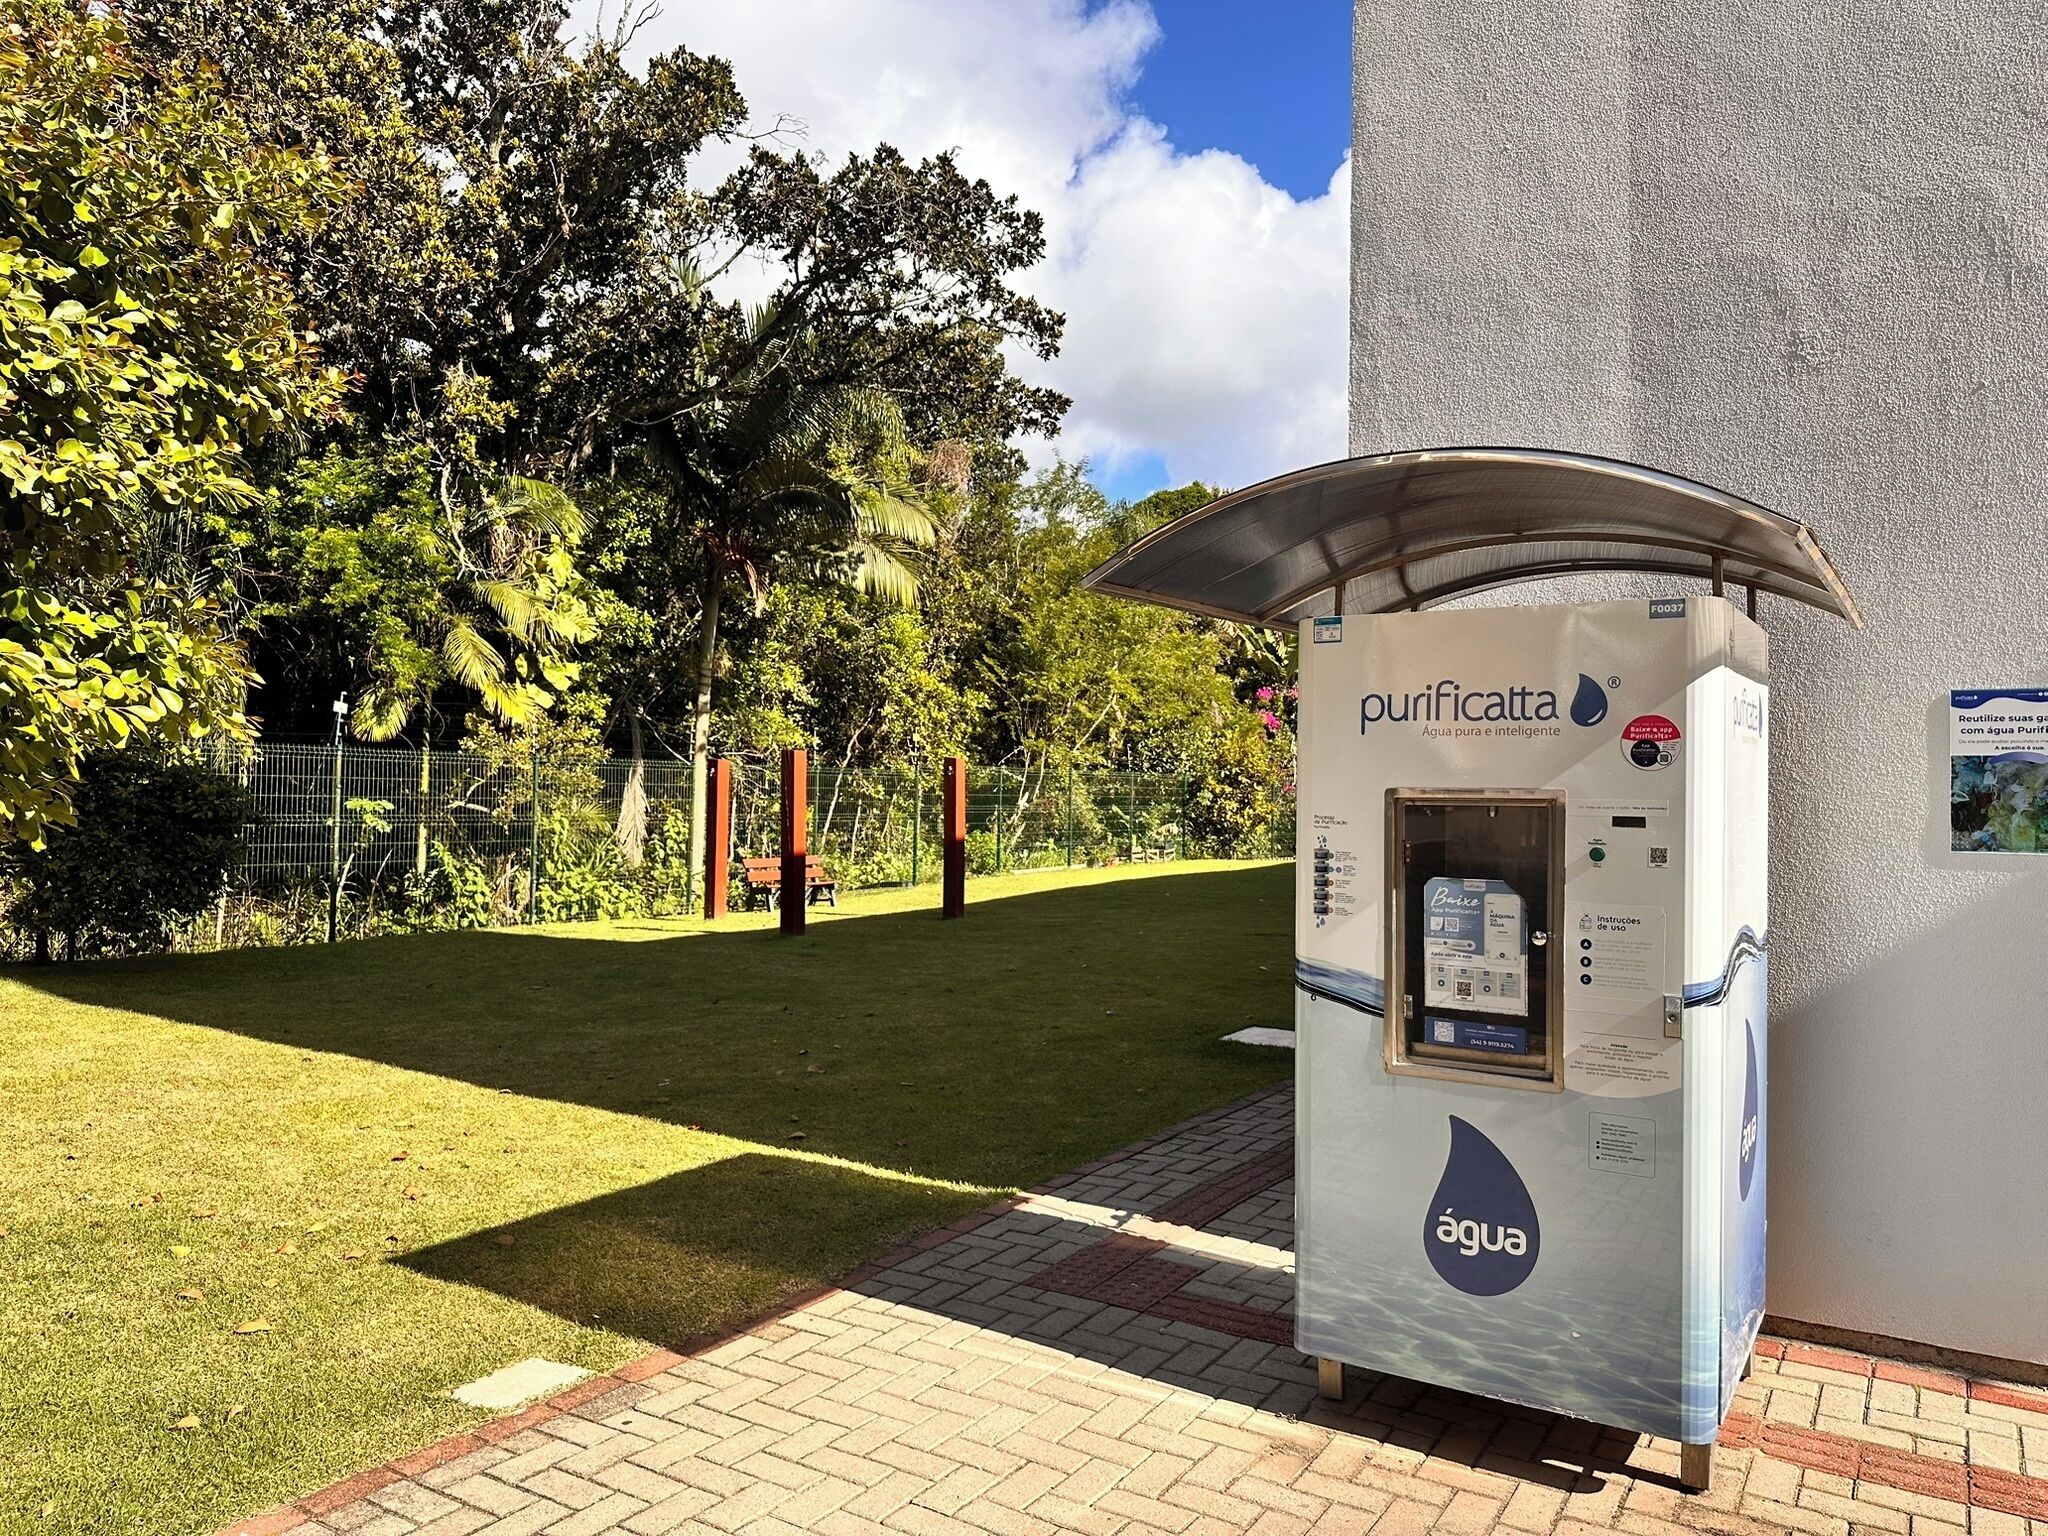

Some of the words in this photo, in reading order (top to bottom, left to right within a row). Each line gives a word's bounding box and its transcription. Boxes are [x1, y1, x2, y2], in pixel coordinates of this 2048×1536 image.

[1651, 603, 1684, 613] F0037
[1360, 680, 1560, 736] purificatta
[1959, 714, 2006, 722] Reutilize
[1421, 723, 1452, 739] Água
[1454, 727, 1481, 739] pura
[1484, 727, 1492, 736] e
[1494, 725, 1561, 739] inteligente
[1987, 725, 2014, 735] água
[1430, 886, 1480, 907] Baixe
[1597, 915, 1641, 925] Instruções
[1597, 923, 1608, 931] de
[1436, 1207, 1527, 1256] água
